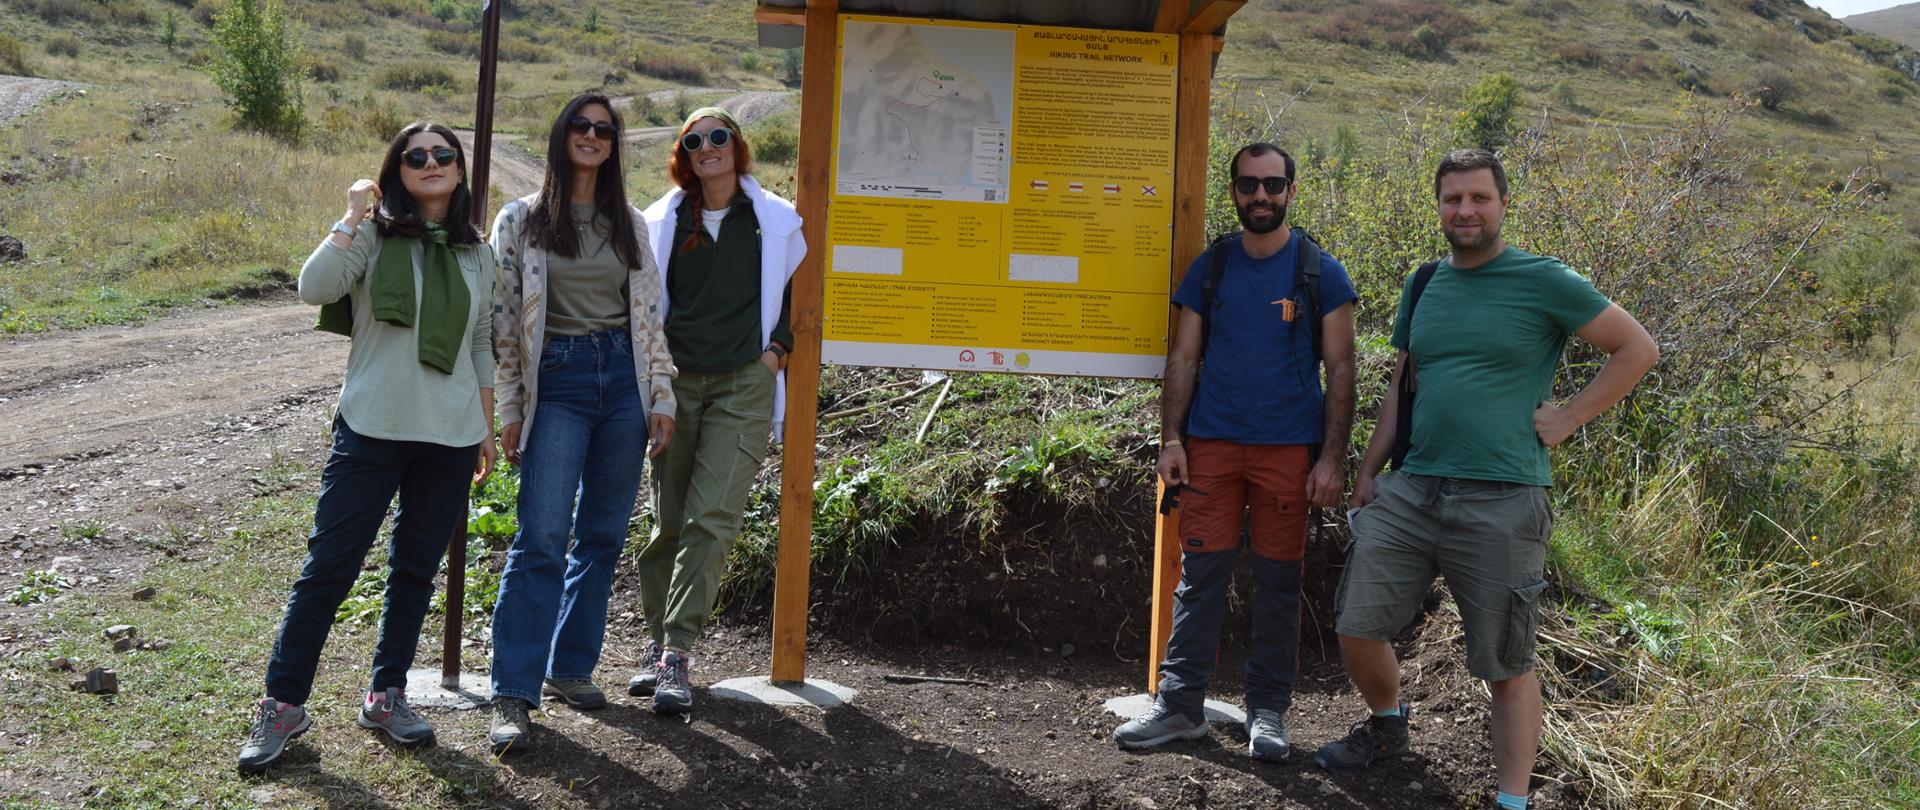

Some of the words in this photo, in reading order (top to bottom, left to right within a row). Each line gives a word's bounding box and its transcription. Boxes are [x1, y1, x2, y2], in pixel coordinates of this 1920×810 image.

[1050, 51, 1077, 60] HIKING
[1079, 53, 1101, 61] TRAIL
[1103, 55, 1143, 63] NETWORK
